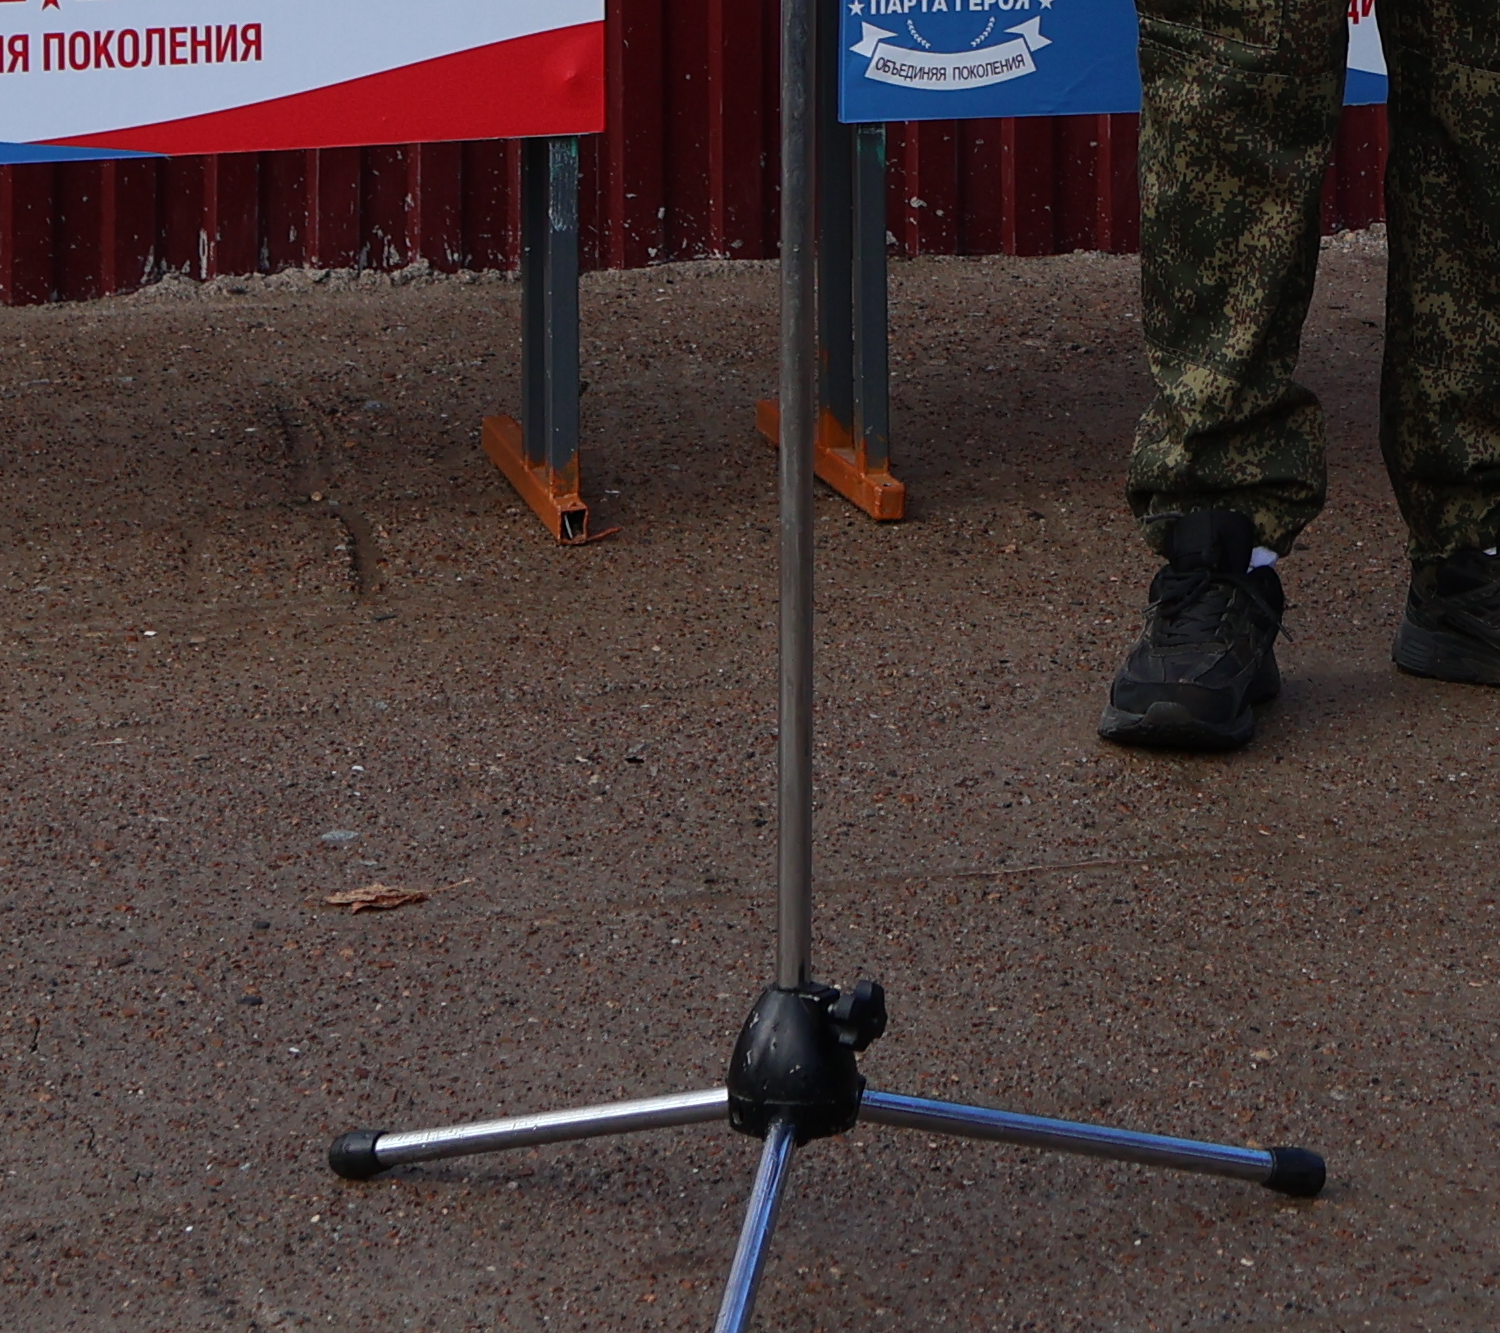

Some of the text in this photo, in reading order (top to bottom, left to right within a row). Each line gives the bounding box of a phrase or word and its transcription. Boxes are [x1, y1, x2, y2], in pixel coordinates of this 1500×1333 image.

[41, 23, 263, 72] ПОКОЛЕНИЯ
[875, 53, 1026, 82] ОБЪЕДИНЯЯ ПОКОЛЕНИЯ
